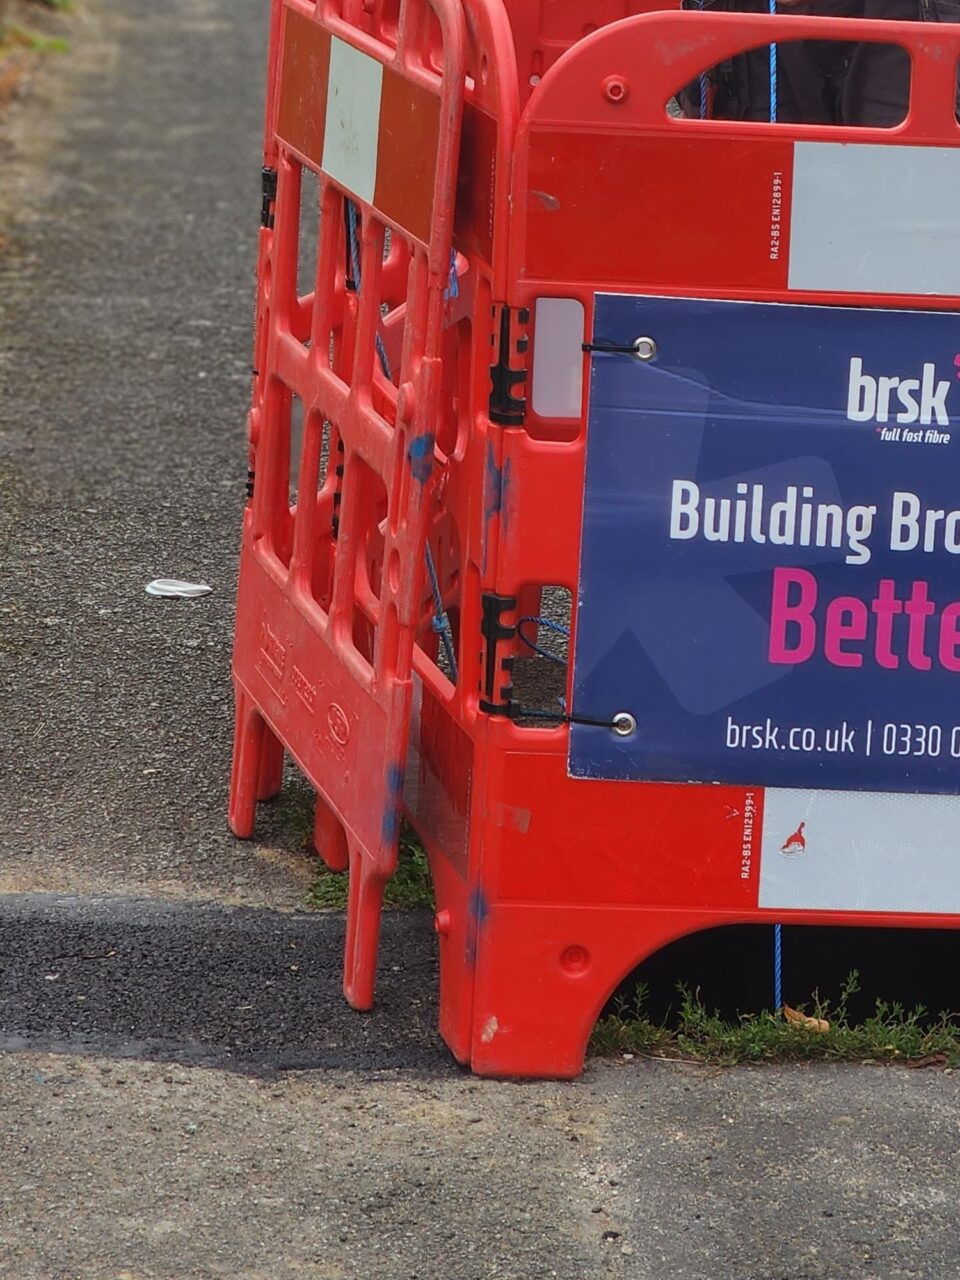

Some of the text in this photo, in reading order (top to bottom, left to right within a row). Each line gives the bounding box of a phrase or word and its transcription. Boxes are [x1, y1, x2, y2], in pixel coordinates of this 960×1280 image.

[771, 172, 783, 222] EN12899-1
[847, 357, 951, 426] brsk
[880, 427, 951, 445] full fast fibre
[669, 479, 877, 565] Building
[726, 716, 855, 753] brsk.co.uk
[883, 723, 942, 757] 0330
